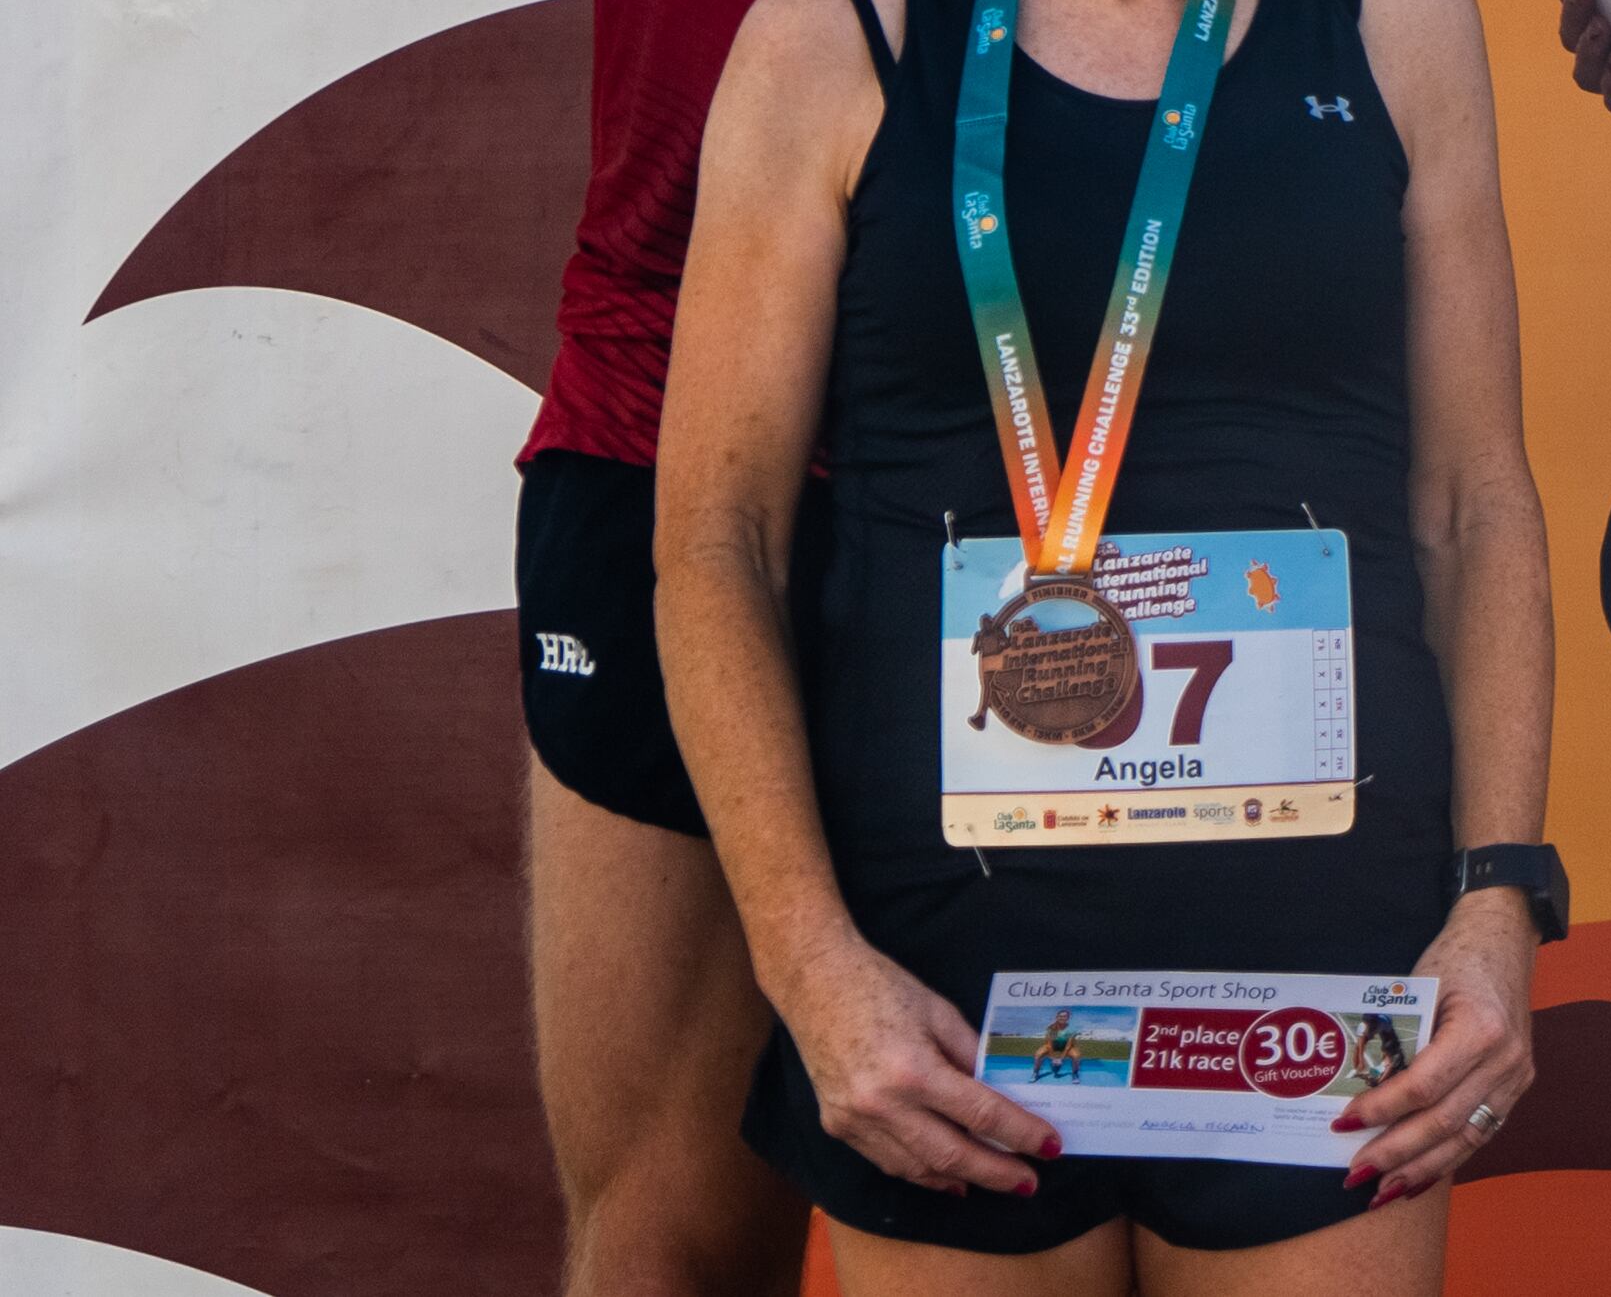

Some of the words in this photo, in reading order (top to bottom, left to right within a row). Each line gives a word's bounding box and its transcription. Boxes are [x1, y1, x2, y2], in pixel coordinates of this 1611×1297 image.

[995, 332, 1035, 451] LANZAROTE
[1060, 452, 1107, 546] RUNNING
[1088, 339, 1135, 462] CHALLENGE
[1130, 218, 1163, 295] EDITION
[1032, 585, 1089, 601] FINISHER
[1106, 581, 1189, 604] Running
[1011, 622, 1113, 651] Lanzarote
[1023, 659, 1108, 681] Running
[1017, 676, 1116, 703] Challenge
[1094, 754, 1203, 786] Angela
[1127, 806, 1187, 821] Lanzarote
[1193, 804, 1236, 820] sports
[1008, 982, 1057, 998] Club
[1063, 982, 1087, 998] La
[1094, 982, 1152, 998] Santa
[1158, 982, 1217, 1002] Sport
[1222, 983, 1277, 1003] Shop
[1361, 991, 1418, 1008] LaSanta
[1367, 984, 1390, 995] Club
[1145, 1024, 1179, 1044] 2nd
[1181, 1025, 1240, 1048] place
[1254, 1022, 1338, 1067] 30€
[1141, 1049, 1184, 1070] 21k
[1187, 1053, 1236, 1072] race
[1254, 1069, 1279, 1084] Gift
[1281, 1064, 1336, 1081] Voucher
